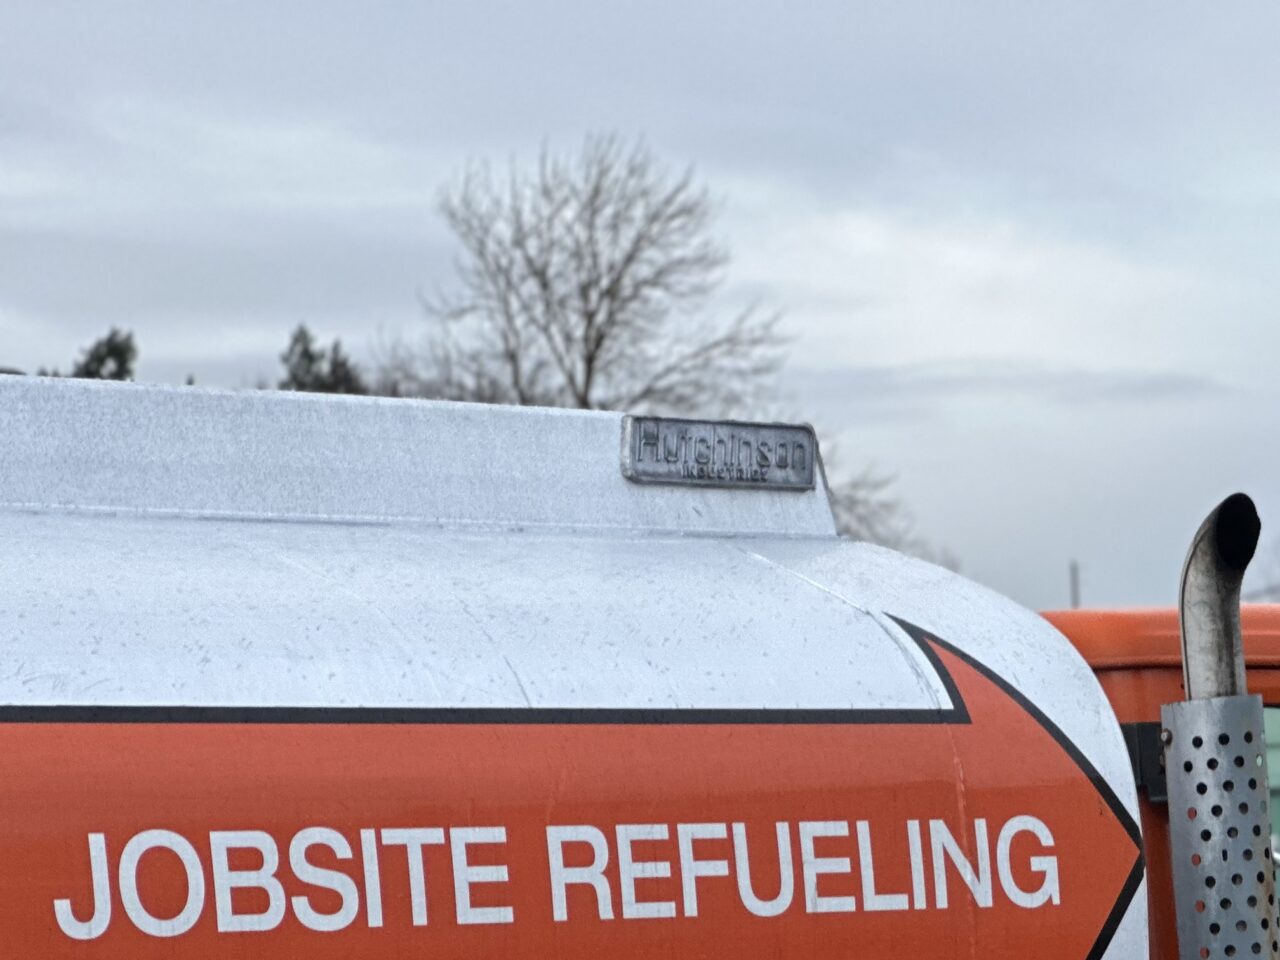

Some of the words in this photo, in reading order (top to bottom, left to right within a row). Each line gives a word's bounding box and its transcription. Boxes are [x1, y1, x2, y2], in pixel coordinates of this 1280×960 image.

[637, 421, 806, 471] Hutchinson
[53, 826, 515, 941] JOBSITE
[545, 814, 1061, 922] REFUELING
